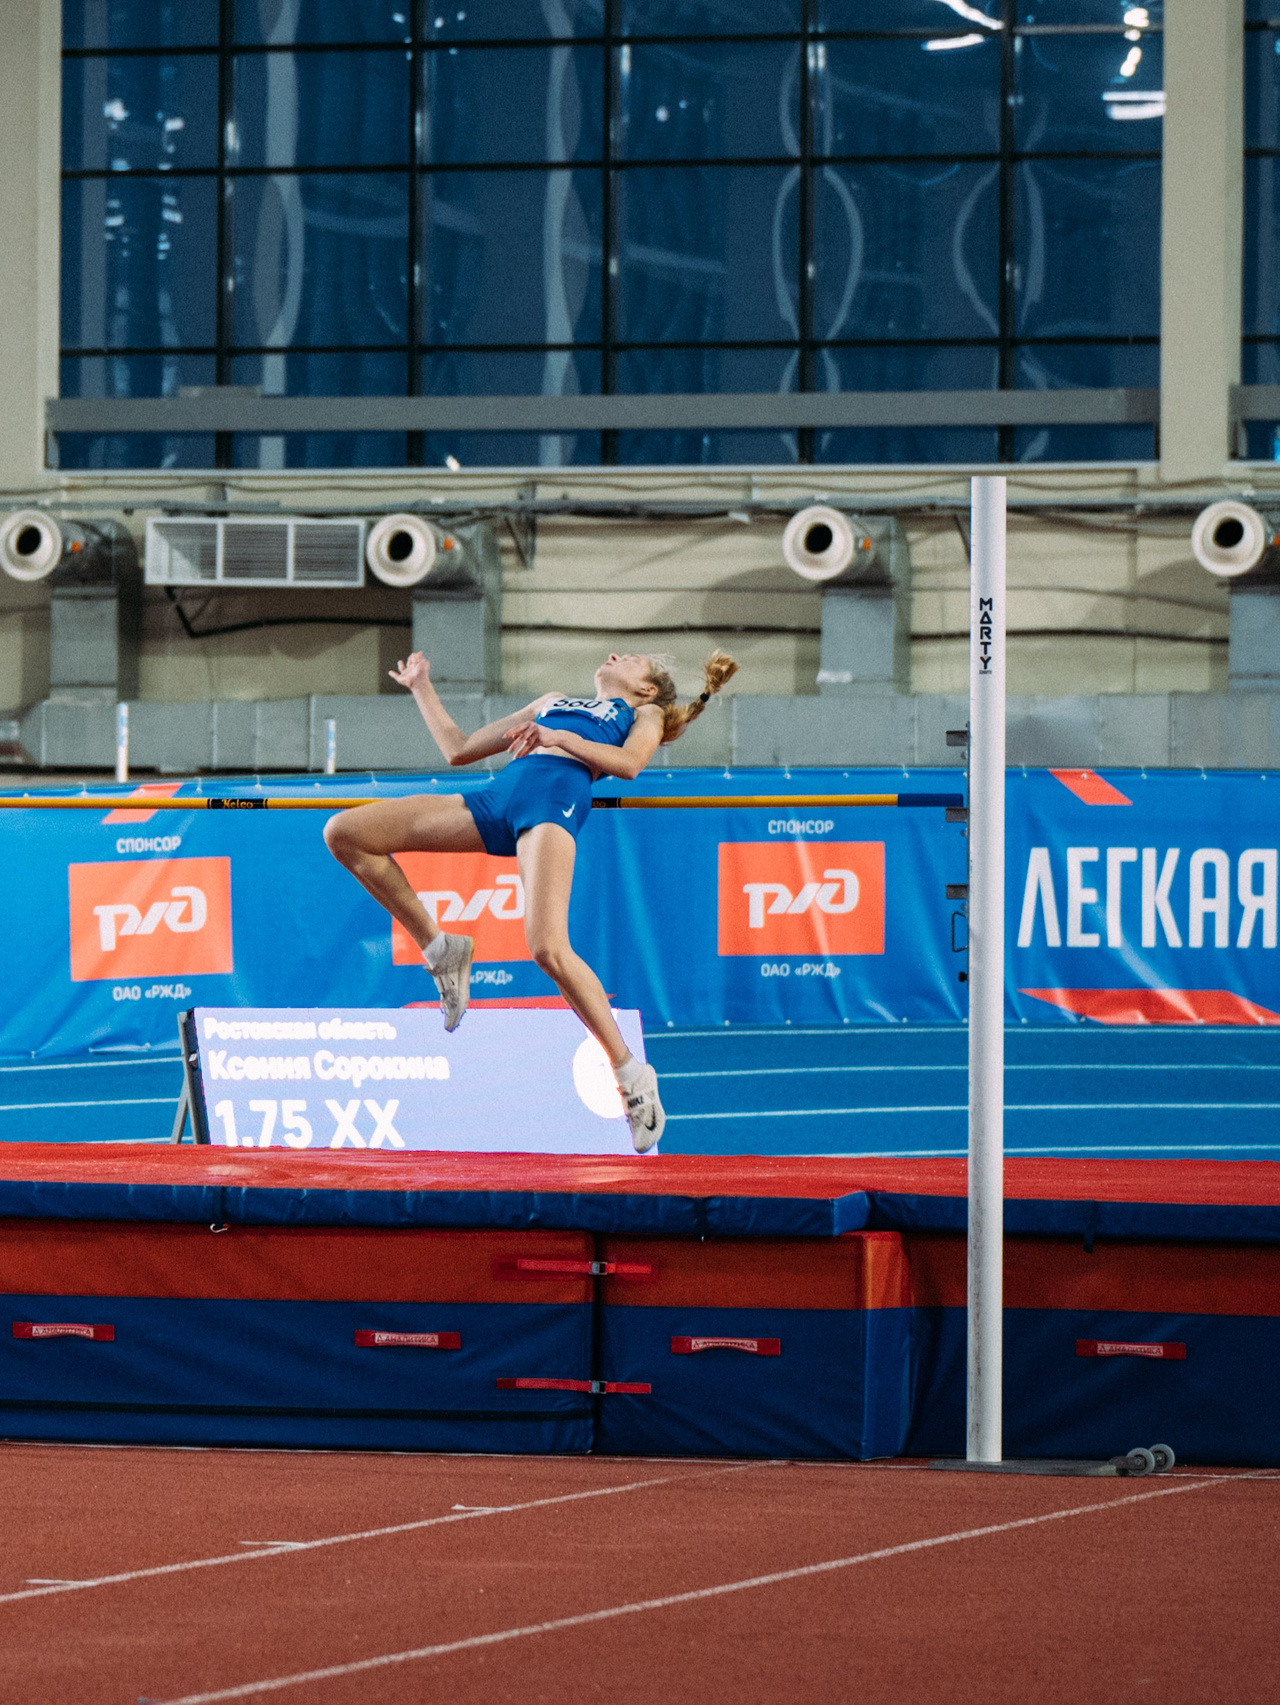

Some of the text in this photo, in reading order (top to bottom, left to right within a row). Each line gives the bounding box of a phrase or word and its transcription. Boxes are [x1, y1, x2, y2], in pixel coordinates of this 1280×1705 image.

[979, 597, 993, 670] MARTY
[768, 820, 835, 834] СПОНСОР
[116, 836, 182, 853] СПОНСОР
[1017, 847, 1279, 949] ЛЕГКАЯ
[760, 962, 841, 978] ОАО «РЖД»
[113, 983, 192, 1001] ОАО «РЖД»
[319, 1018, 397, 1040] область
[208, 1050, 450, 1088] Ксения Сорокина
[215, 1100, 313, 1148] 1.75
